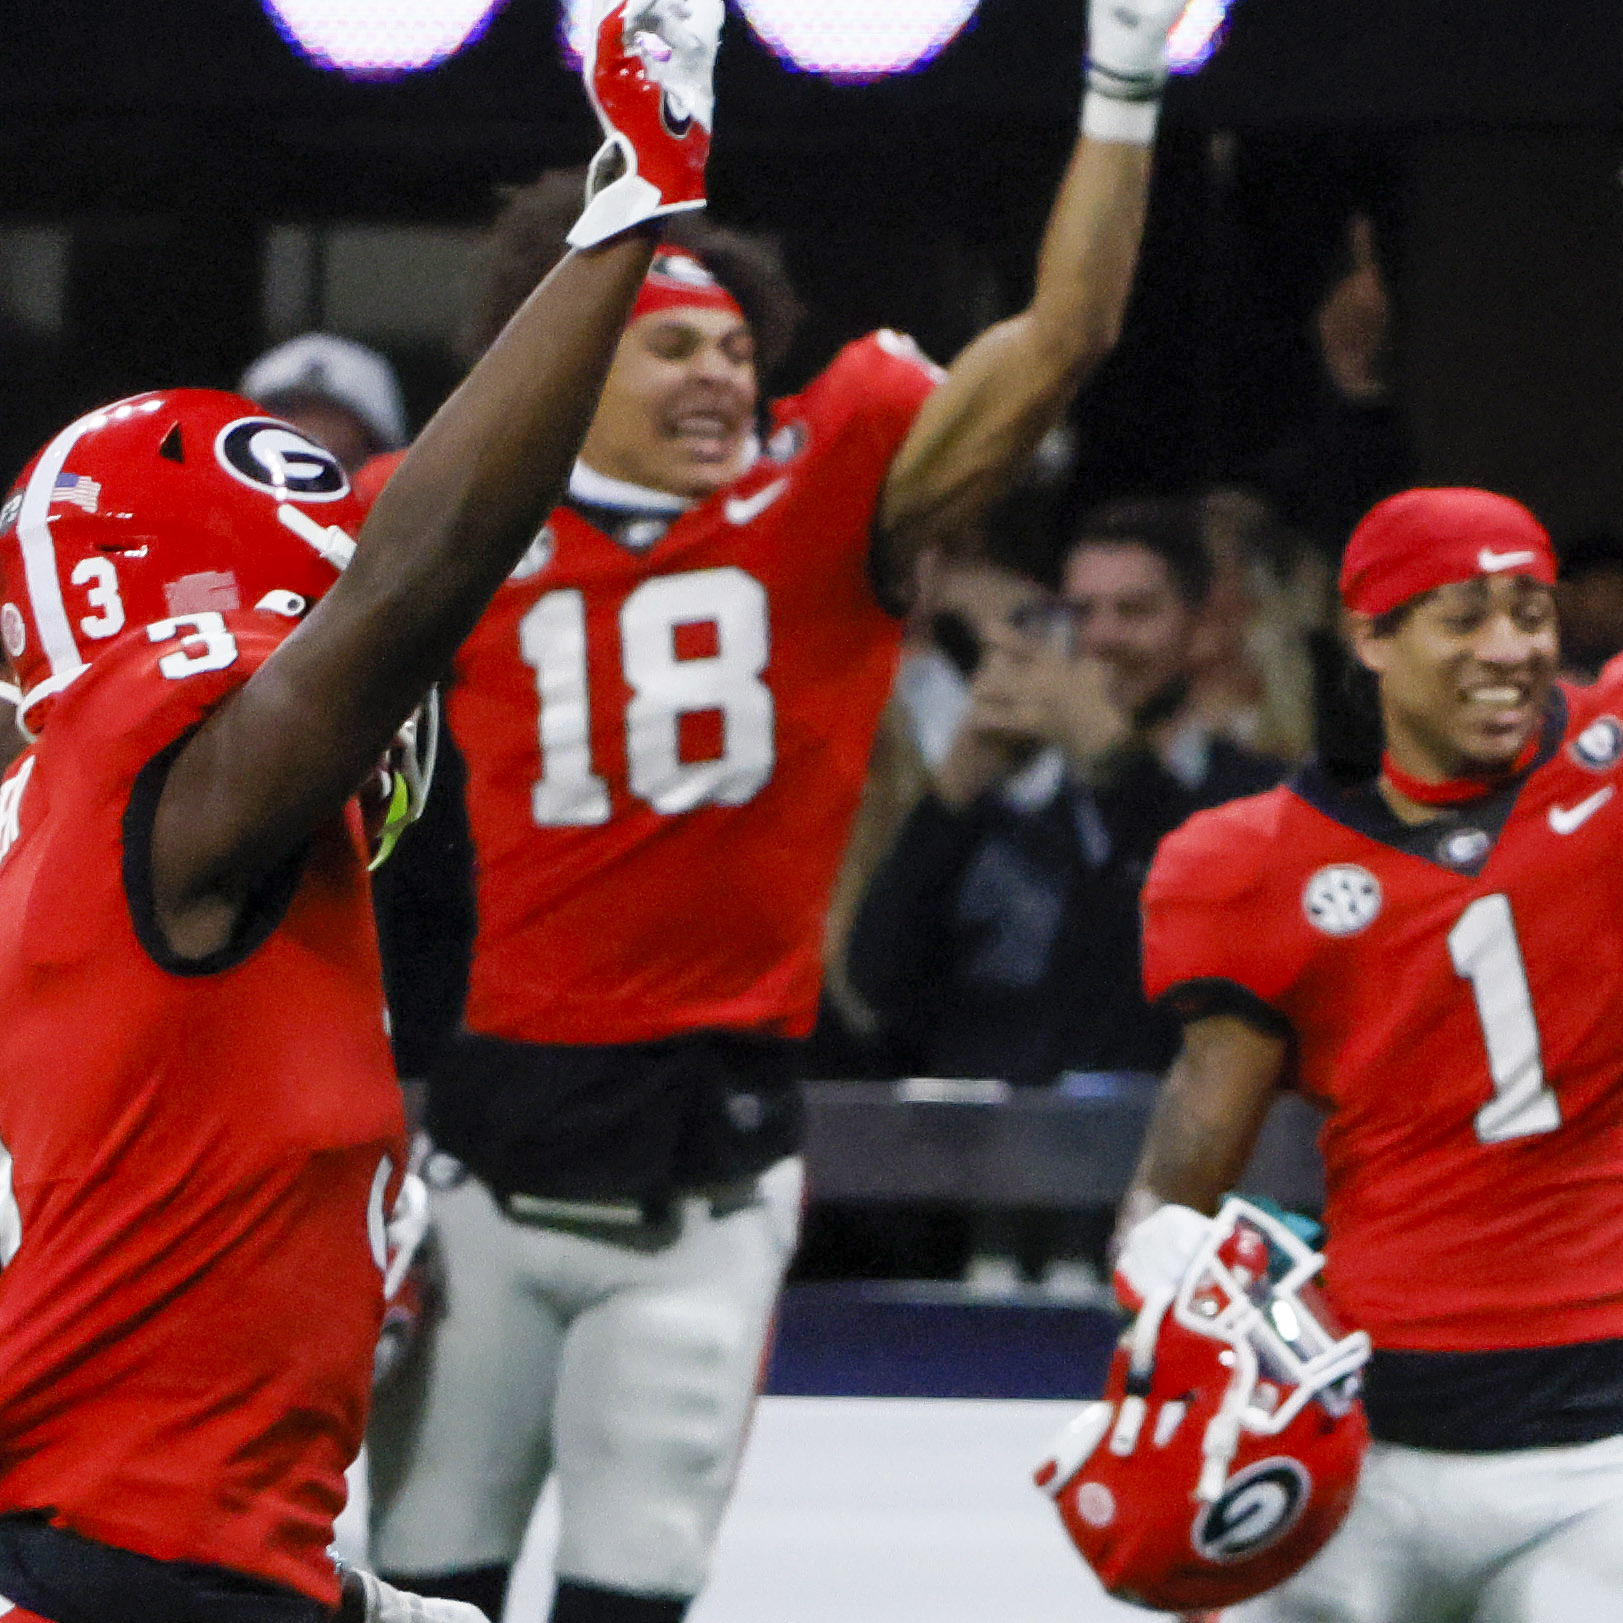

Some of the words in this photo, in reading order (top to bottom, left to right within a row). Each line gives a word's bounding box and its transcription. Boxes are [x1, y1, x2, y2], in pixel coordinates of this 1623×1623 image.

[71, 557, 125, 639] 3
[147, 611, 238, 679] 3
[518, 566, 777, 828] 18
[1446, 892, 1563, 1143] 1
